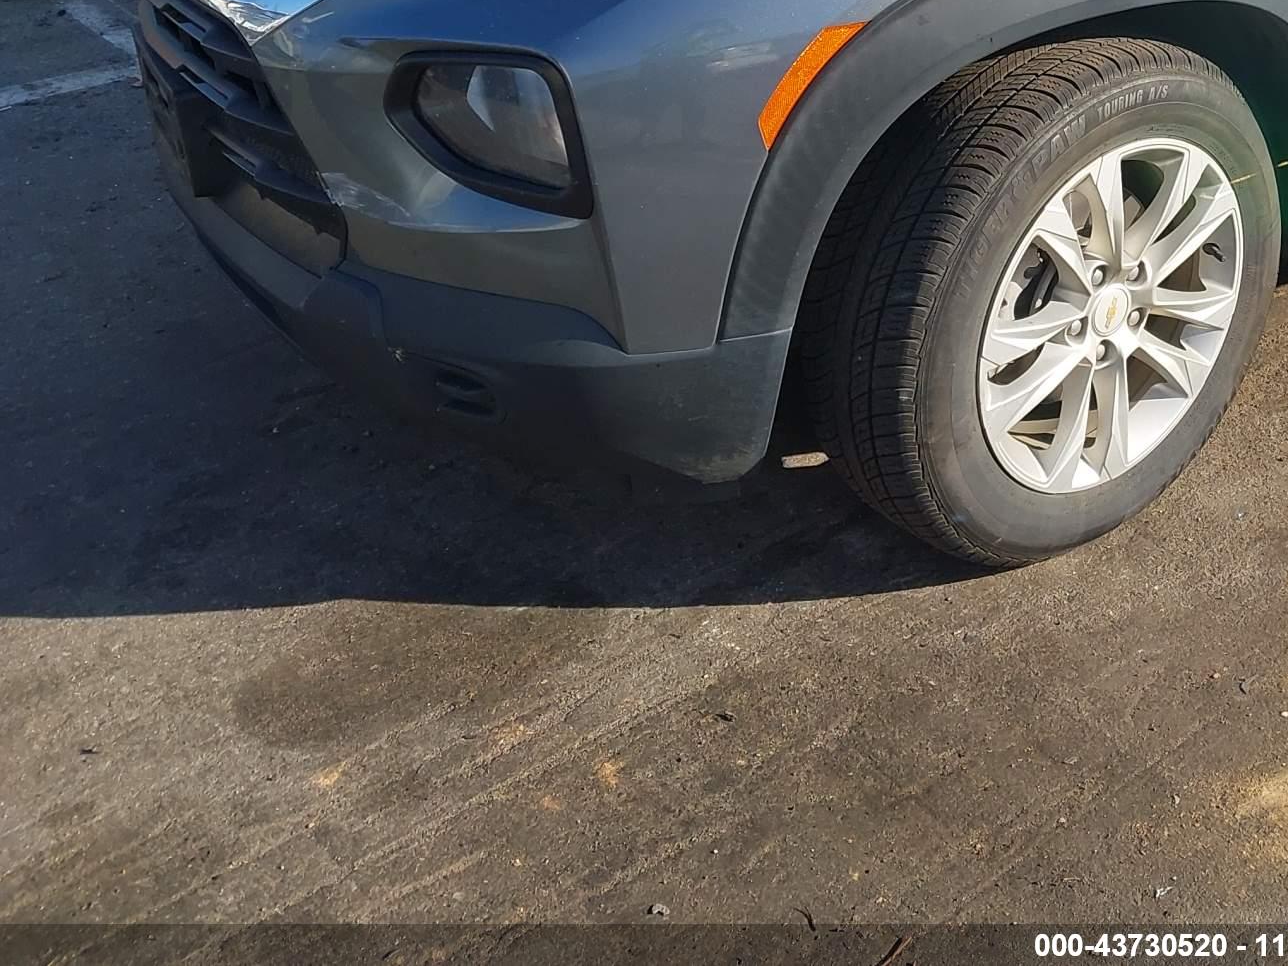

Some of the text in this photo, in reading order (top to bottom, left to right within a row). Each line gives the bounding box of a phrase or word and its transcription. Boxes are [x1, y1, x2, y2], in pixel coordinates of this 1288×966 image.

[1032, 114, 1086, 180] PAW
[1097, 90, 1143, 122] TOURING
[1148, 84, 1169, 101] A/S
